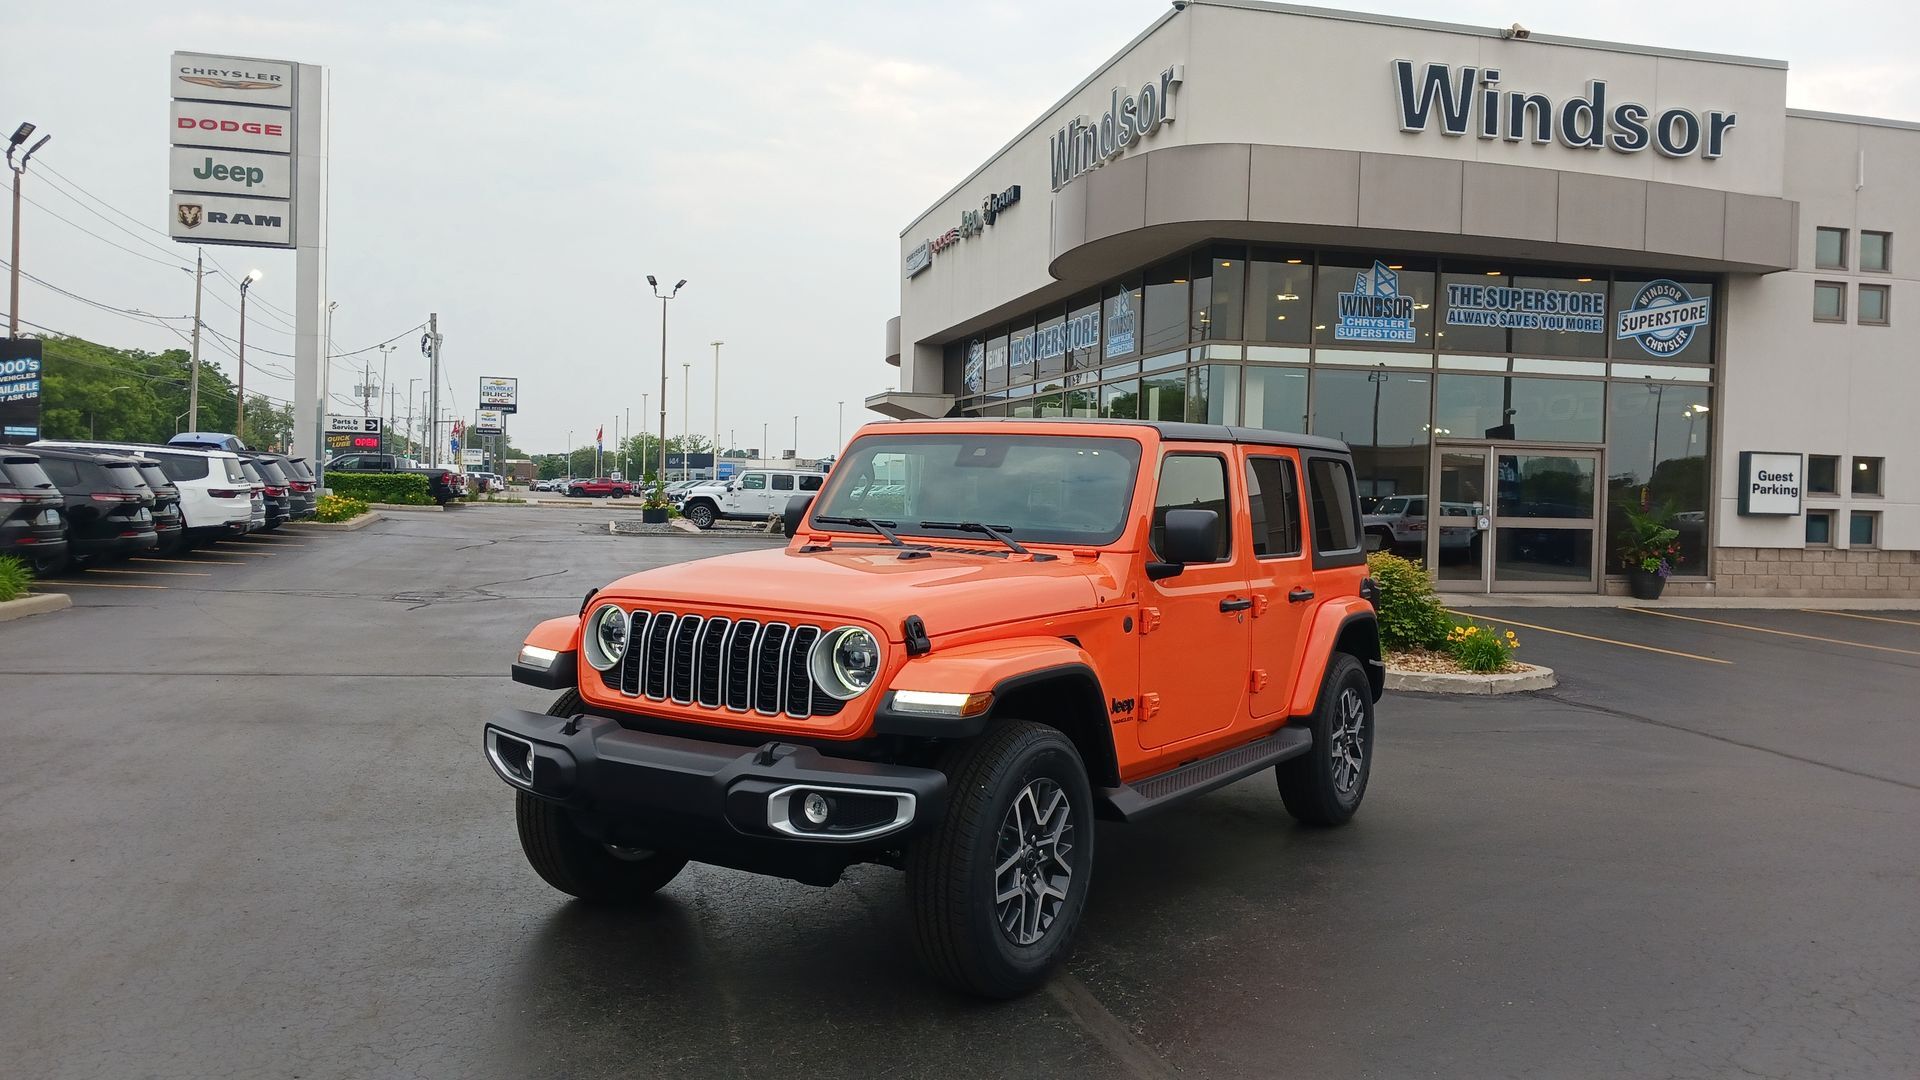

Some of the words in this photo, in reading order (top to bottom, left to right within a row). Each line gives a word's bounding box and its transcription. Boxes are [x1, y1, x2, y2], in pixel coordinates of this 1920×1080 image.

[180, 66, 281, 82] CHRYSLER
[1391, 58, 1736, 159] Windsor
[177, 117, 282, 136] DODGE
[1050, 65, 1184, 192] Windsor
[193, 157, 264, 187] Jeep
[207, 211, 282, 228] RAM
[1449, 285, 1484, 306] THE
[1486, 286, 1604, 314] SUPERSTORE
[1639, 285, 1682, 306] WINDSOR
[1340, 295, 1412, 319] WINDSOR
[1346, 317, 1405, 328] CHRYSLER
[1449, 310, 1497, 324] ALWAYS
[1500, 311, 1538, 327] SAVES
[1541, 316, 1564, 329] YOU
[1566, 317, 1603, 331] MORE!
[1621, 305, 1706, 332] SUPERSTORE
[1024, 312, 1099, 364] SUPERSTORE
[1338, 327, 1413, 339] SUPERSTORE
[1645, 329, 1688, 352] CHRYSLER
[7, 394, 24, 402] ASK
[26, 391, 38, 399] US
[327, 434, 351, 442] QUICK
[354, 438, 378, 448] OPEN
[1758, 470, 1793, 482] Guest
[1752, 483, 1798, 498] Parking
[1110, 697, 1135, 714] Jeep
